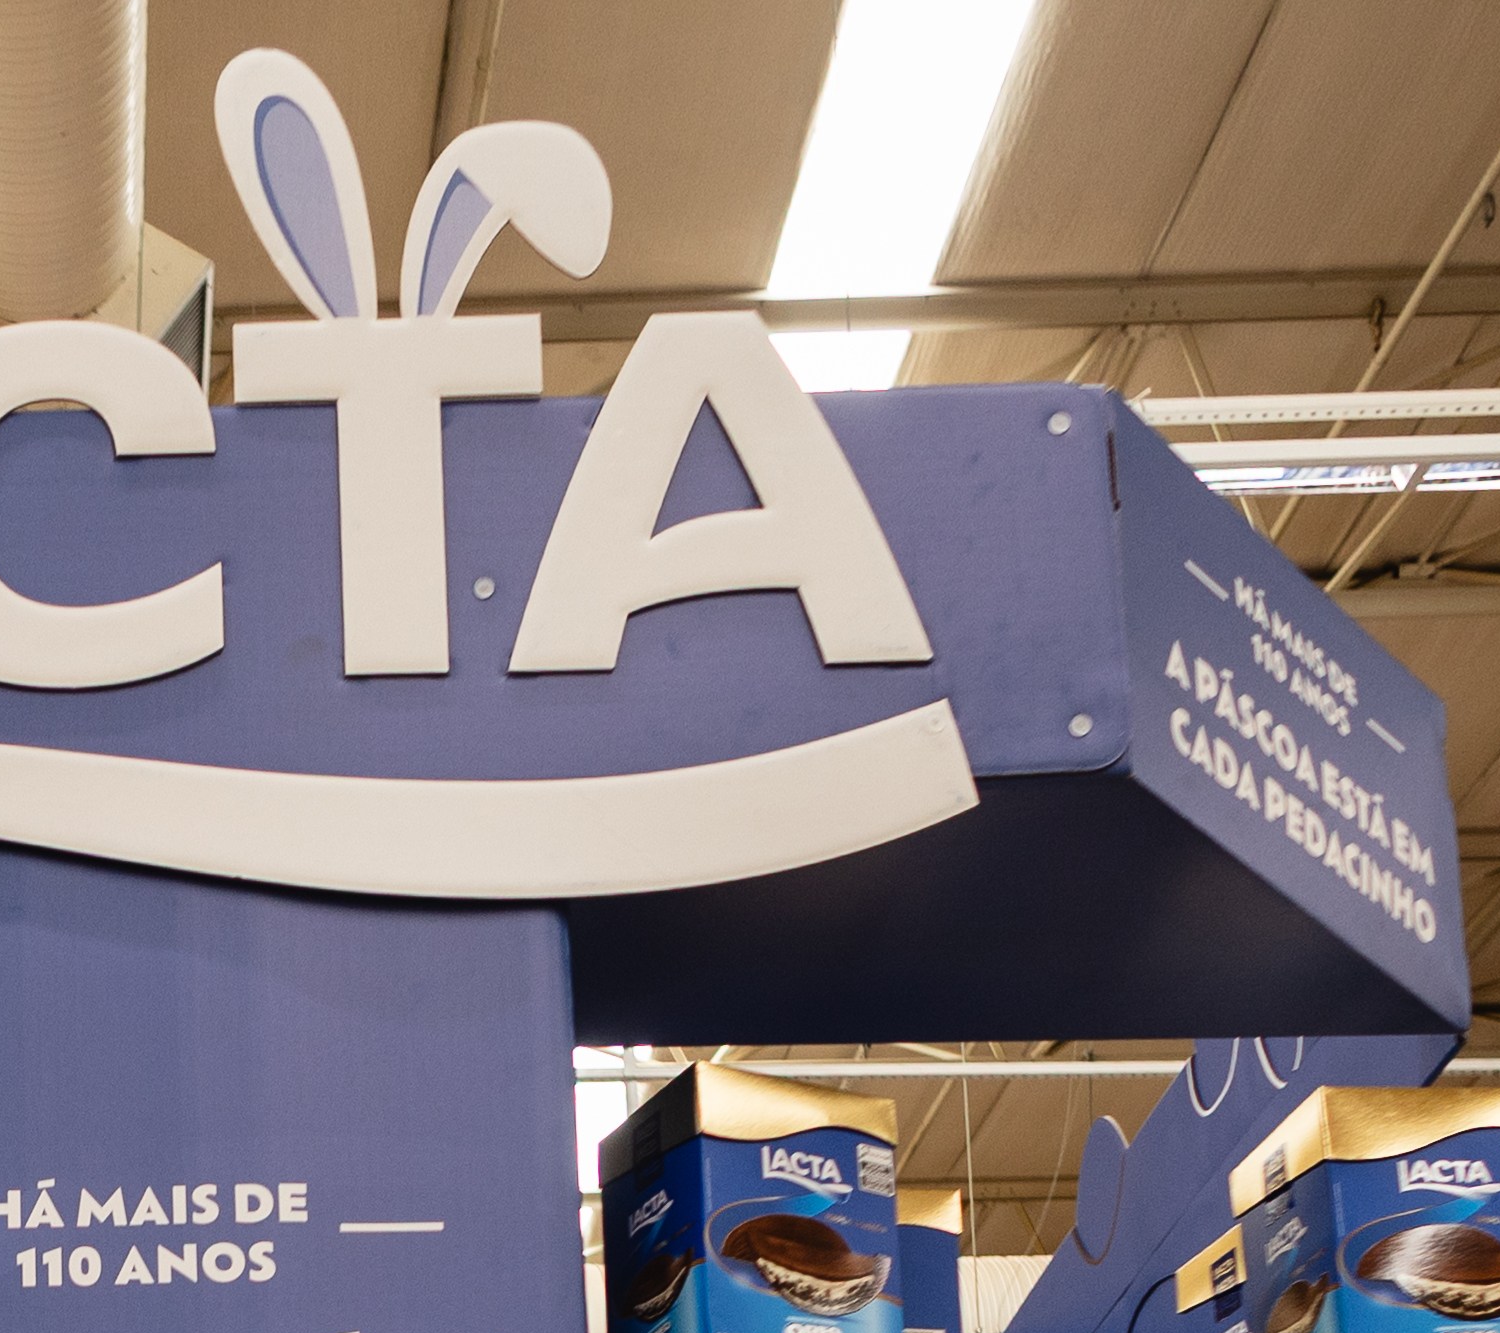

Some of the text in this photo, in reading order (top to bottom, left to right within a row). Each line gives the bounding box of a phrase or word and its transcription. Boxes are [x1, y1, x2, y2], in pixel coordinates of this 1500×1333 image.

[1234, 576, 1358, 707] HÁ MAIS DE
[1251, 634, 1350, 736] 110 ANOS
[1164, 640, 1435, 887] A PÁSCOA ESTÁ EM
[1170, 707, 1436, 943] CADA PEDACINHO
[762, 1146, 847, 1187] LACTA
[1397, 1159, 1500, 1195] LACTA
[77, 1184, 219, 1228] MAIS
[235, 1182, 308, 1224] DE
[16, 1240, 277, 1287] 110 ANOS
